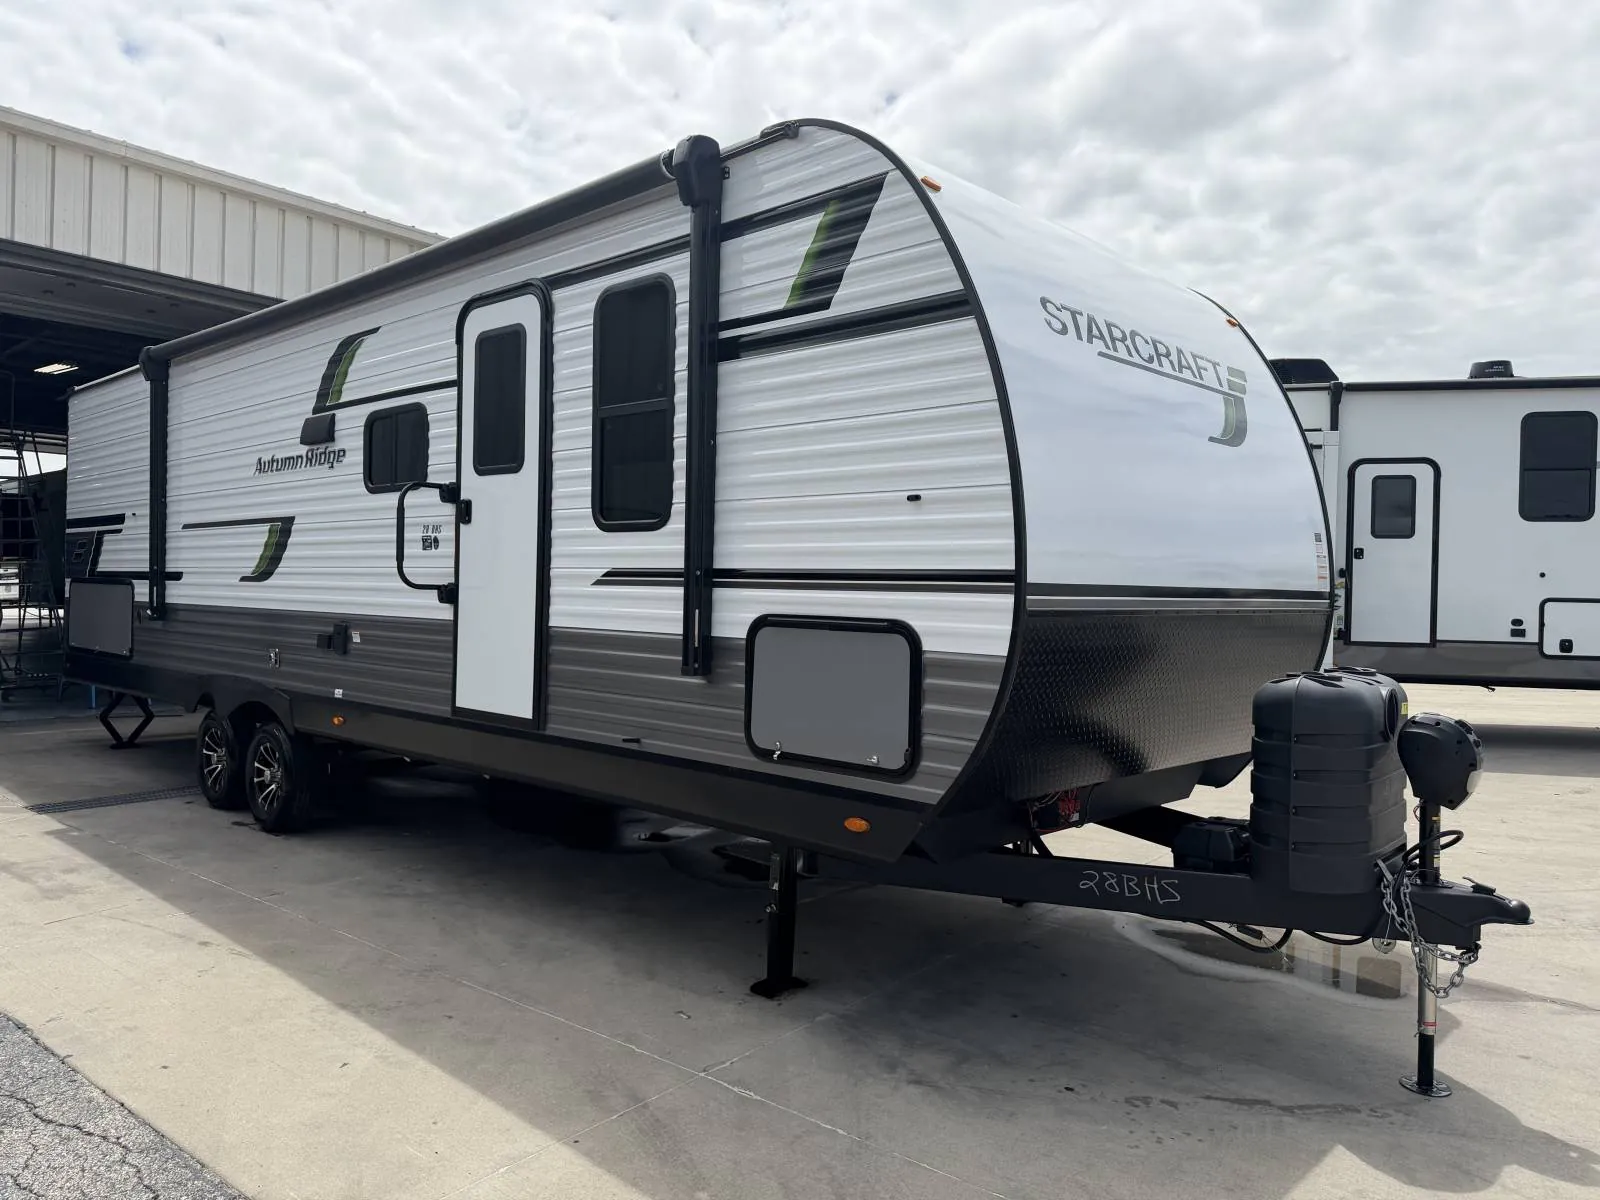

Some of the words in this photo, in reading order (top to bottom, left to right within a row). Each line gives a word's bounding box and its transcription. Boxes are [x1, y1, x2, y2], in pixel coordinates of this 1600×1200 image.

[1040, 296, 1224, 388] STARCRAFT
[253, 454, 303, 476] Autumn
[304, 446, 346, 469] Ridge
[1080, 870, 1180, 904] 28BHS
